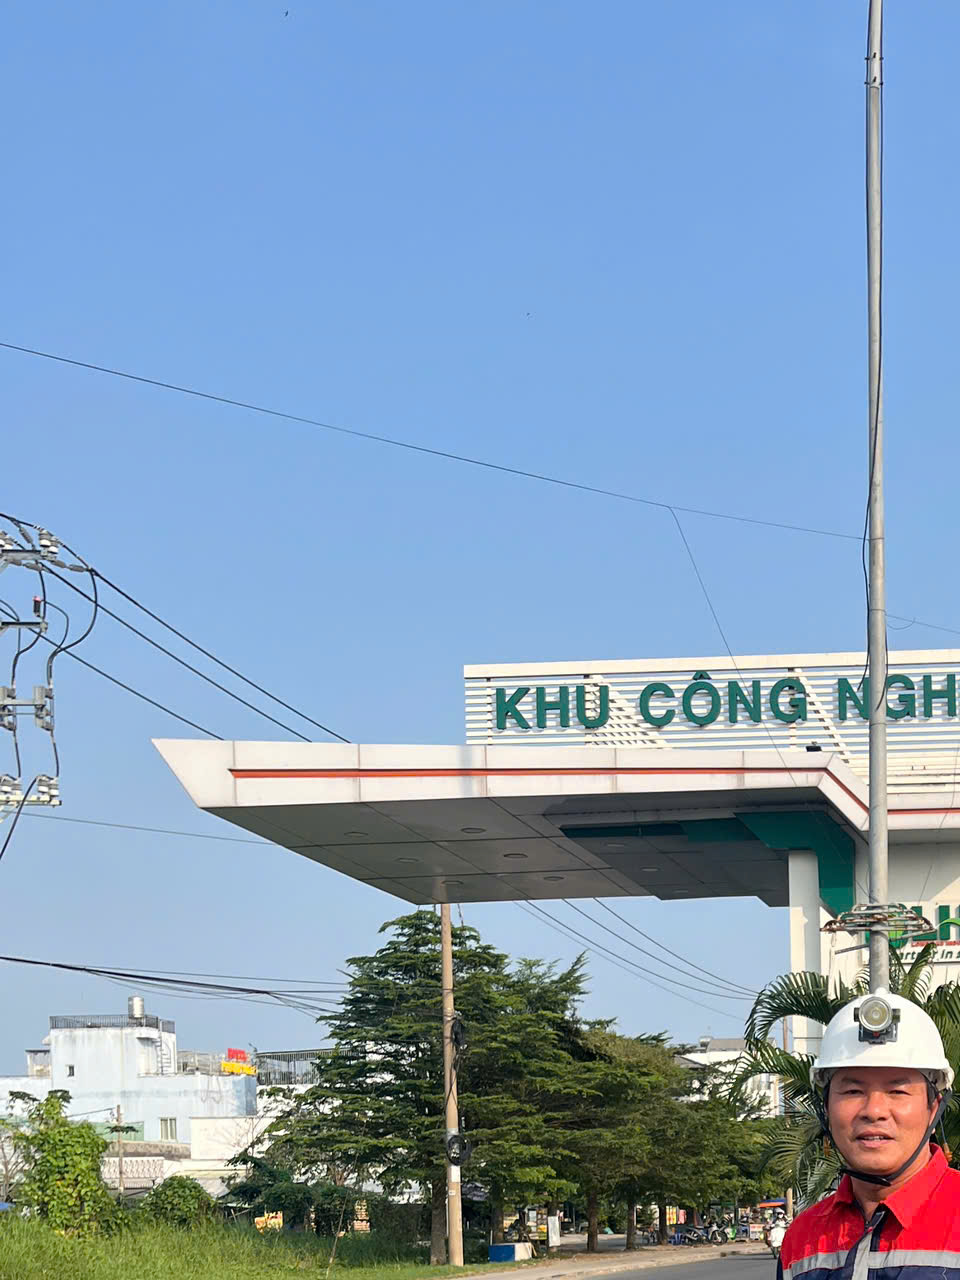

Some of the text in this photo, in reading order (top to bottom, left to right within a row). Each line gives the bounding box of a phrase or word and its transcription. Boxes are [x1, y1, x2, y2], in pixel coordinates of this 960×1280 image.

[495, 682, 609, 730] KHU
[639, 670, 808, 727] CÔNG
[941, 949, 953, 959] in
